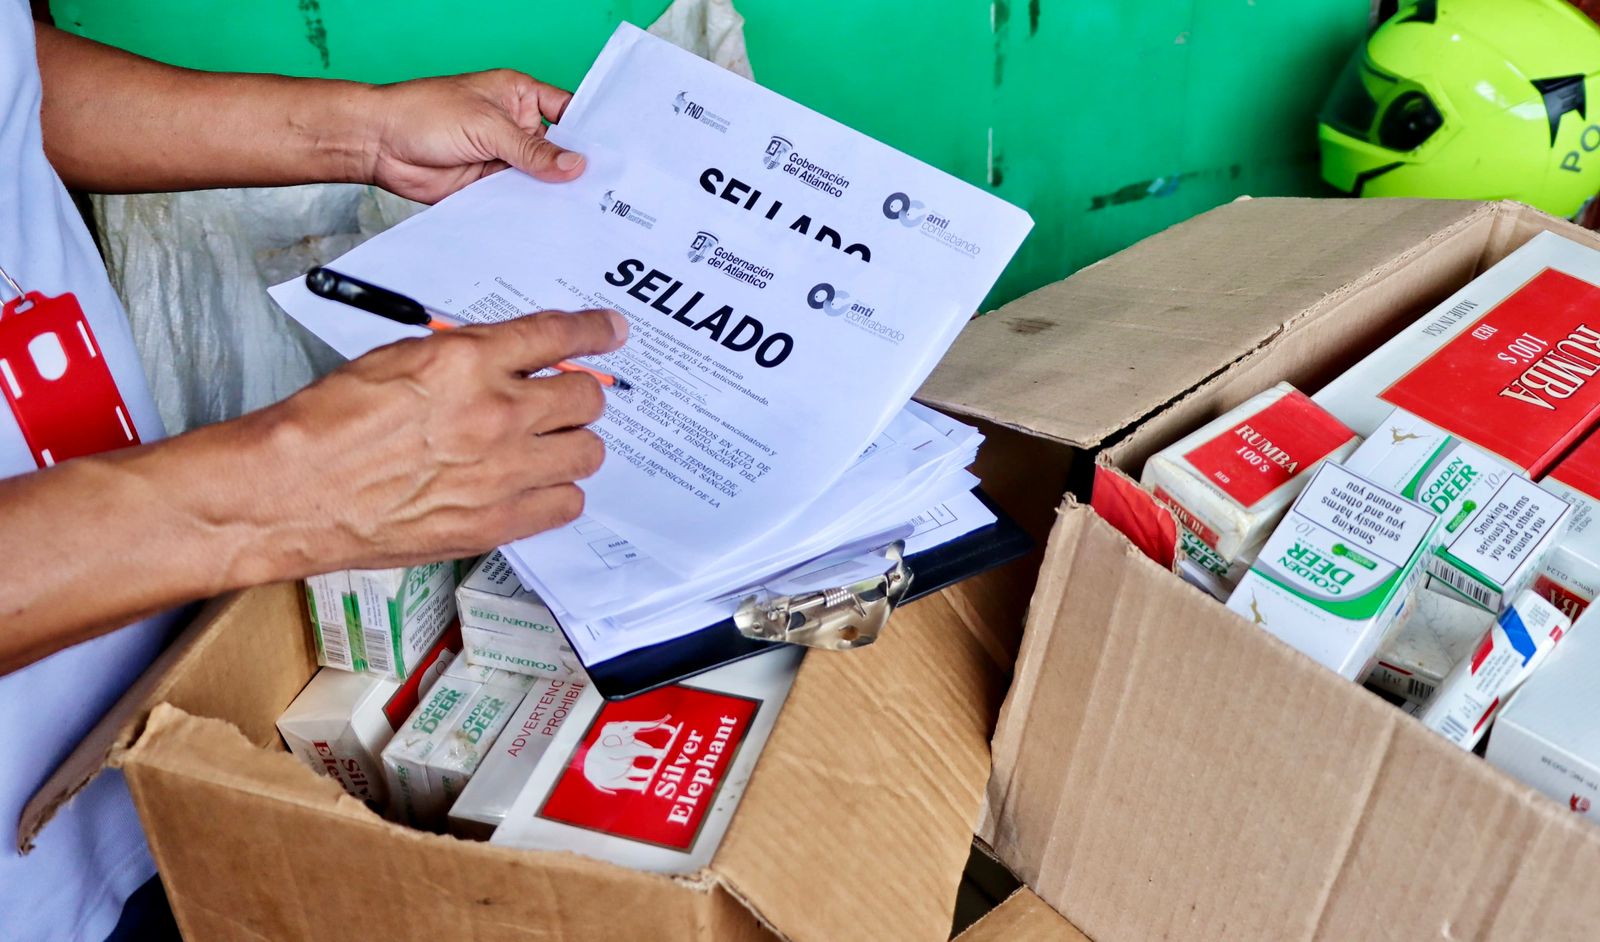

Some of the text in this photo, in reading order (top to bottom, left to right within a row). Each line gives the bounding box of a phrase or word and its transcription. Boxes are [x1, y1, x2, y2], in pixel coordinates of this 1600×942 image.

[683, 101, 704, 120] FND
[782, 162, 845, 199] del Atlántico
[787, 151, 850, 189] Gobernación
[610, 199, 631, 218] FND
[925, 212, 950, 229] anti
[707, 255, 768, 291] del Atlántico
[713, 244, 775, 282] Gobernación
[488, 292, 525, 316] APREHENS
[604, 258, 794, 368] SELLADO
[850, 301, 874, 318] anti
[1422, 299, 1479, 337] MADE IN USA
[613, 303, 643, 323] temporal
[642, 320, 652, 328] de
[651, 325, 703, 357] establecimiento
[702, 354, 713, 363] de
[711, 359, 744, 380] comercio
[1471, 323, 1498, 340] RED
[610, 361, 633, 376] C-403
[632, 374, 643, 382] de
[641, 329, 652, 338] de
[668, 345, 679, 354] de
[678, 350, 698, 365] 2015
[696, 361, 710, 373] Ley
[710, 370, 770, 406] Anticontrabando.
[664, 353, 674, 362] de
[619, 357, 630, 366] 24
[629, 364, 643, 374] Ley
[642, 372, 662, 385] 1762
[660, 383, 671, 391] de
[720, 420, 771, 453] sancionatorio
[605, 403, 655, 438] BLECIMIENTO
[655, 436, 673, 449] POR
[672, 447, 685, 457] EL
[685, 455, 723, 481] TERMINO
[722, 479, 738, 490] DE
[635, 405, 671, 428] QUEDAN
[683, 434, 735, 469] DISPOSICION
[738, 469, 759, 483] DEL
[657, 400, 719, 440] RELACIONADOS
[718, 439, 732, 449] EN
[732, 447, 755, 463] ACTA
[756, 462, 771, 473] DE
[1234, 424, 1299, 473] RUMBA
[612, 438, 634, 453] PARA
[645, 459, 694, 491] IMPOSICION
[694, 489, 708, 500] DE
[708, 498, 720, 508] LA
[623, 425, 635, 434] DE
[636, 433, 648, 442] LA
[648, 441, 698, 474] RESPECTIVA
[698, 472, 736, 498] SANCION
[718, 448, 752, 470] AVALUO
[1214, 470, 1229, 483] RED
[1235, 445, 1270, 473] 100's
[1420, 455, 1464, 503] GOLDEN
[1329, 486, 1405, 531] you and others
[1345, 480, 1402, 516] around you
[1430, 462, 1478, 515] DEER
[1319, 495, 1400, 542] seriously harms
[1330, 513, 1375, 544] Smoking
[1473, 500, 1508, 536] Smoking
[1475, 493, 1529, 555] seriously harms
[1489, 502, 1539, 559] you and others
[1506, 516, 1546, 560] around you
[487, 561, 505, 580] others
[1276, 555, 1342, 596] GOLDEN
[1285, 540, 1355, 587] DEER
[413, 603, 449, 650] you and others
[415, 595, 440, 623] Smoking
[469, 609, 554, 632] GOLDEN DEER
[418, 616, 445, 652] around you
[472, 648, 556, 671] GOLDEN DEER
[411, 686, 448, 730] GOLDEN
[421, 688, 461, 734] DEER
[465, 696, 504, 744] DEER
[508, 676, 564, 757] ADVERTENC
[652, 728, 704, 800] Silver
